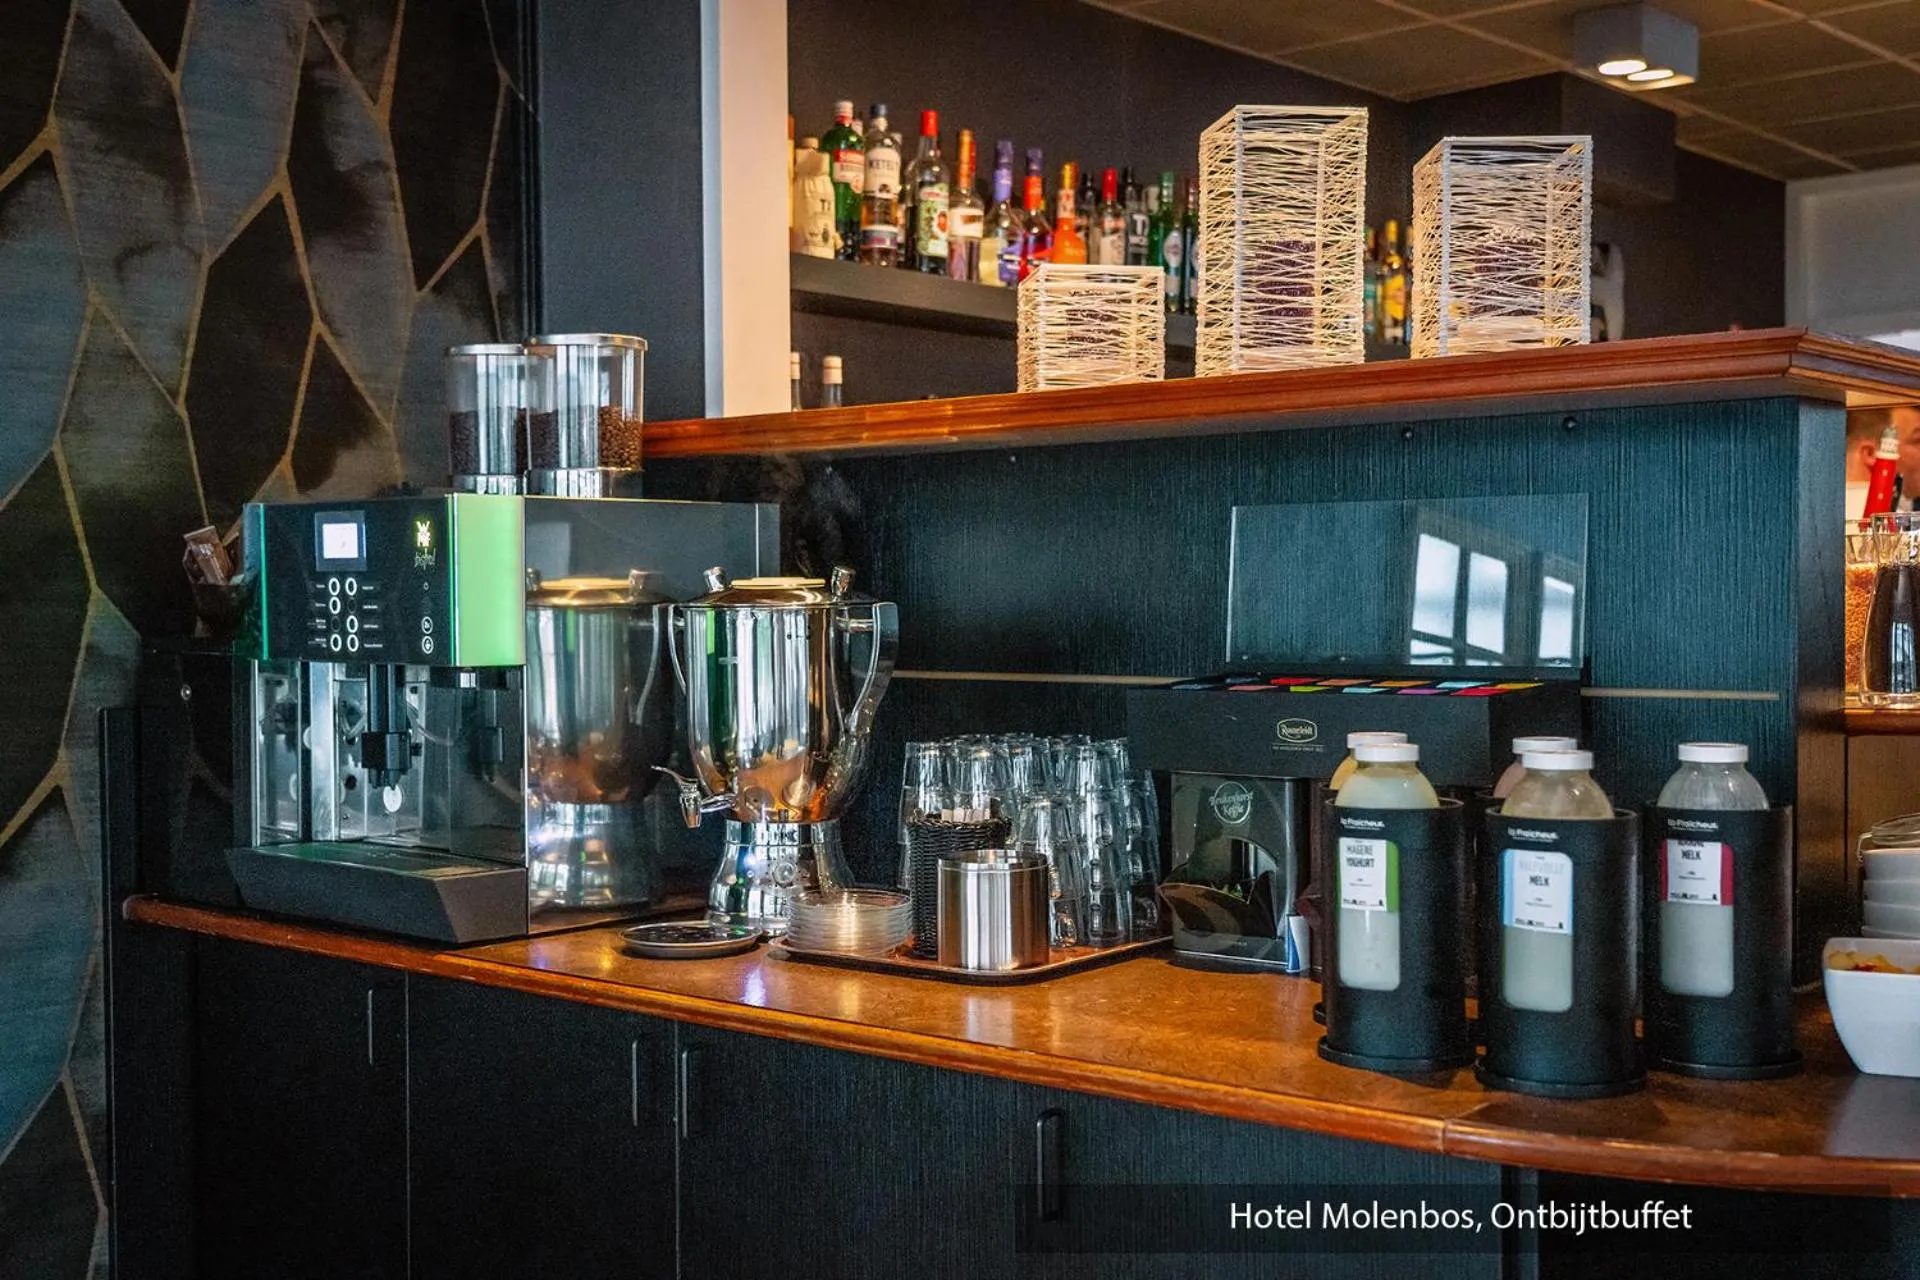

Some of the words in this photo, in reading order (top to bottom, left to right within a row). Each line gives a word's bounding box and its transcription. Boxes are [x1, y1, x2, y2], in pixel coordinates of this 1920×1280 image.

[1681, 849, 1702, 860] MELK
[1346, 858, 1375, 868] YOGHURT
[1528, 875, 1549, 886] MELK
